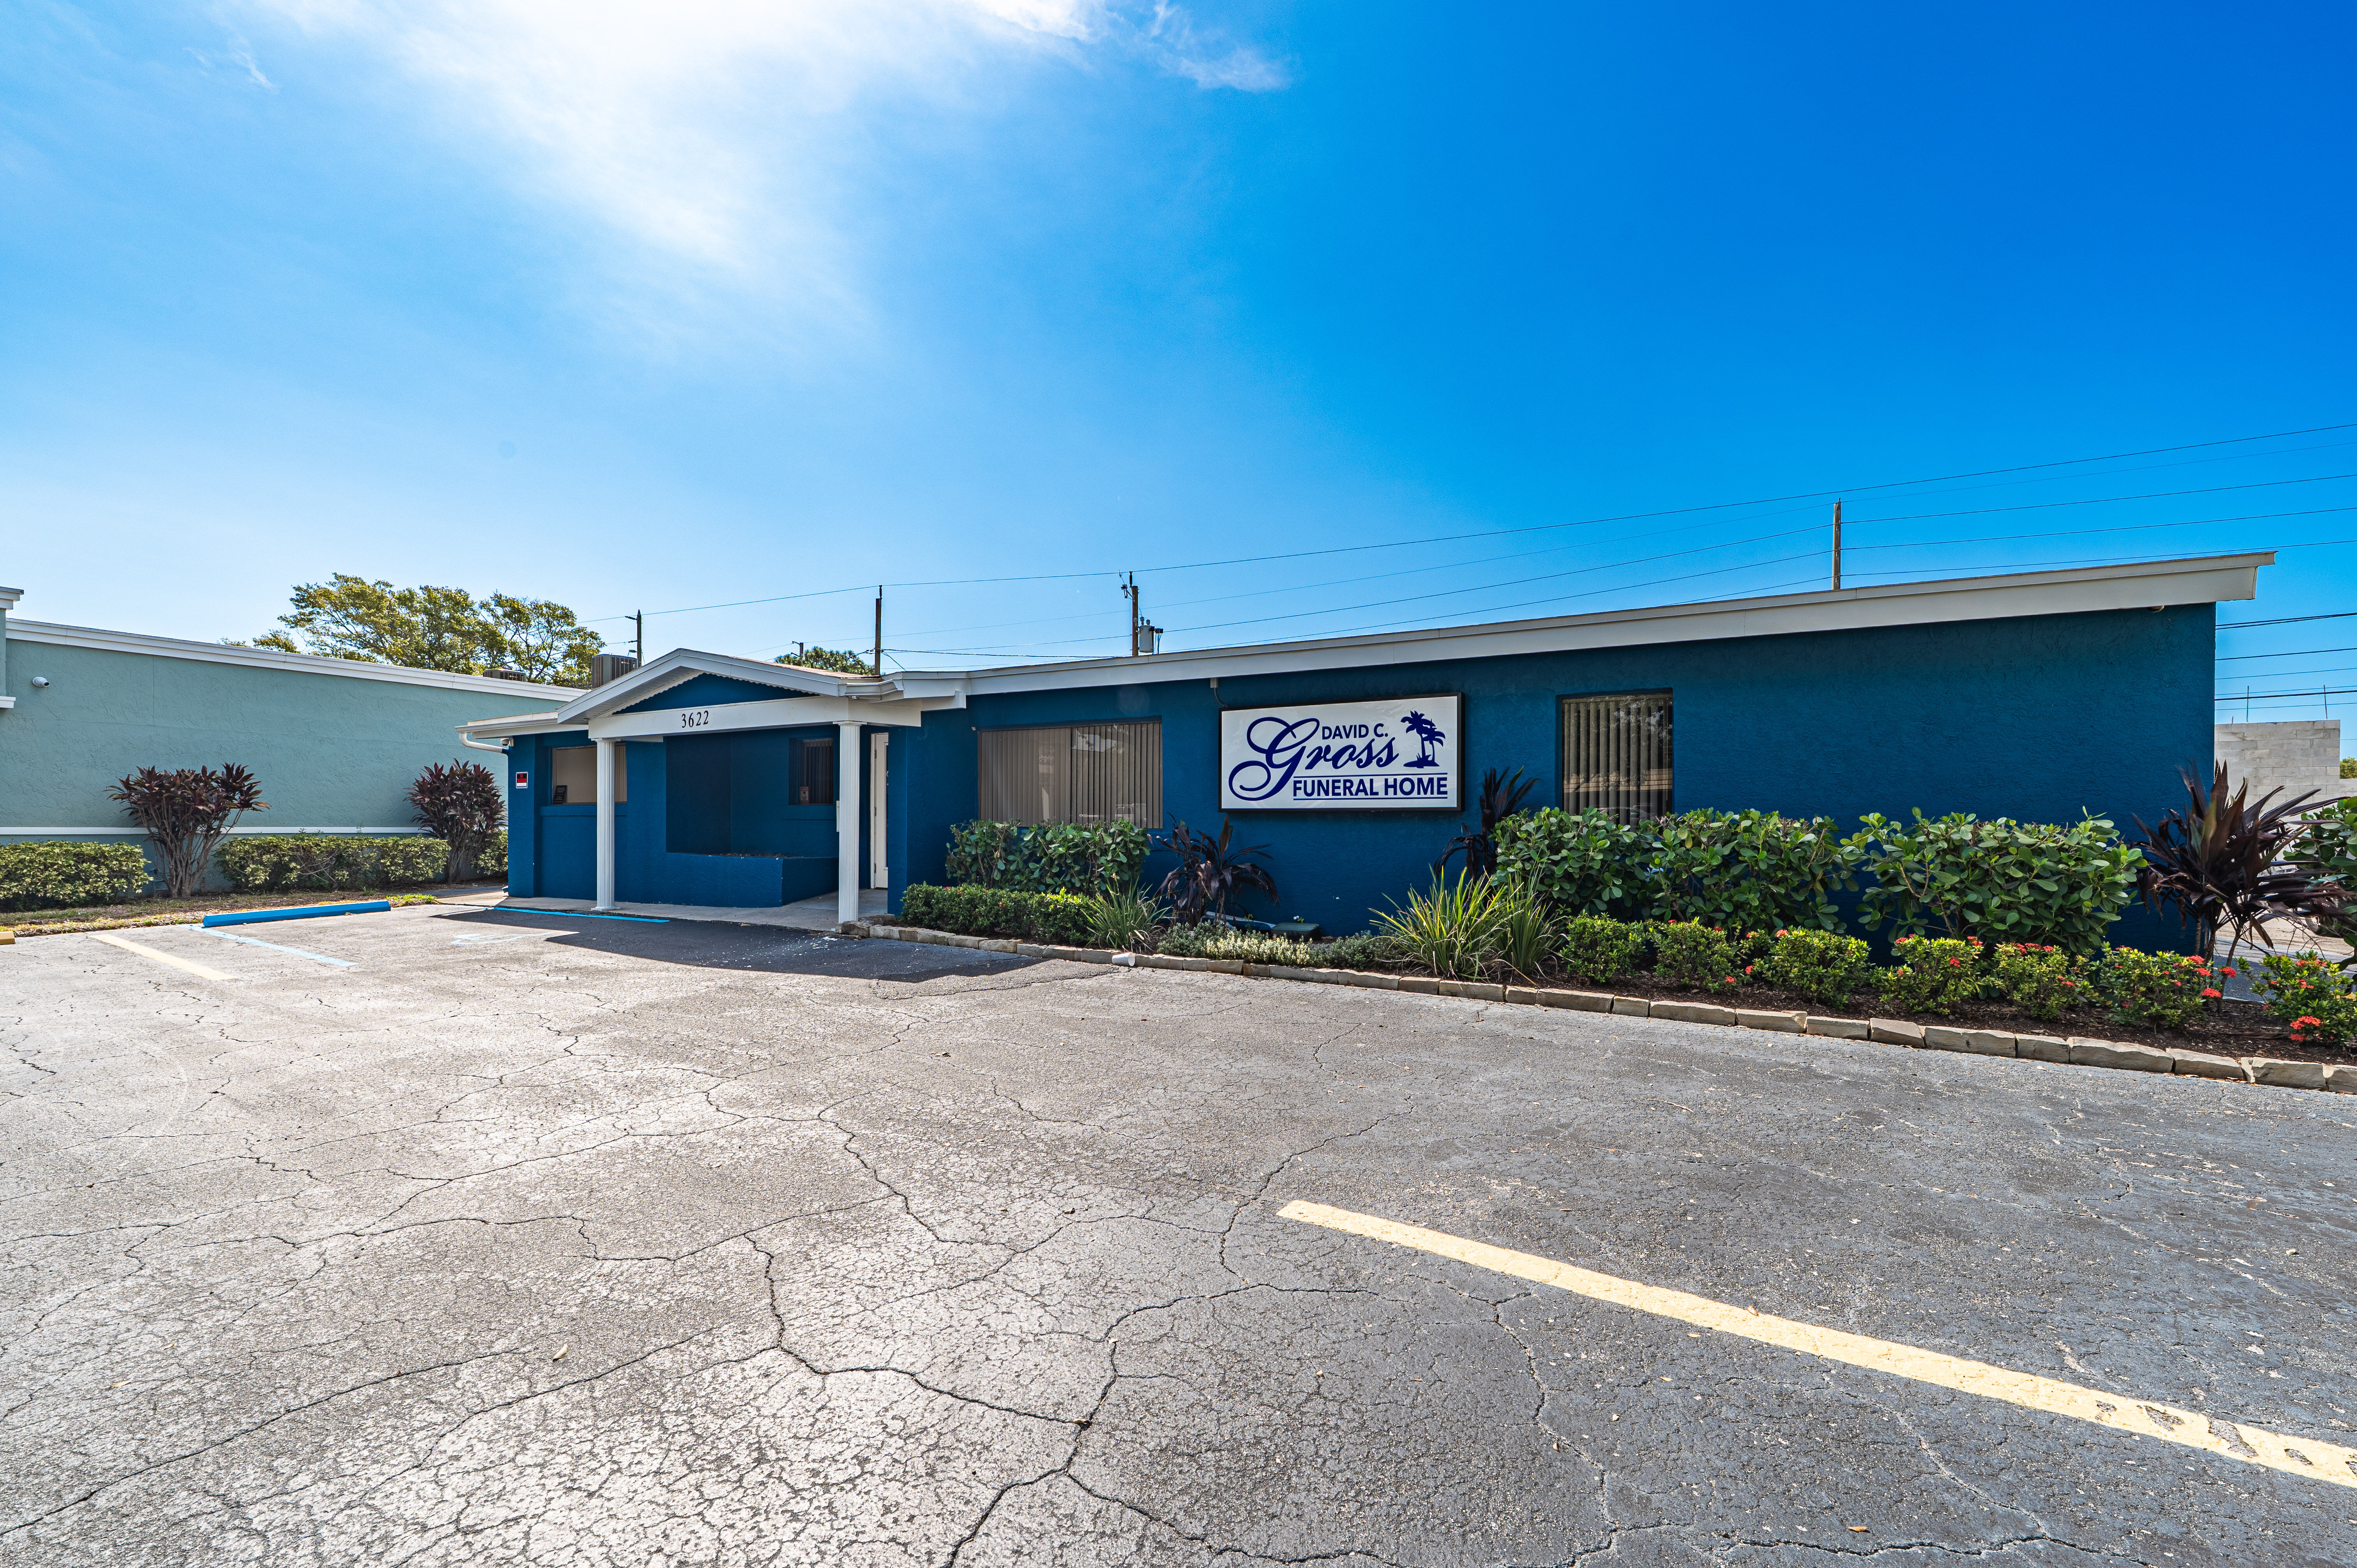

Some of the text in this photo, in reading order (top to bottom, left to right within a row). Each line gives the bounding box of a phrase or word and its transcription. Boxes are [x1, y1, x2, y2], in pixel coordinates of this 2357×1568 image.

[682, 710, 709, 728] 3622
[1322, 723, 1388, 740] DAVID C.
[1229, 717, 1399, 801] Gross
[1293, 777, 1448, 797] FUNERAL HOME
